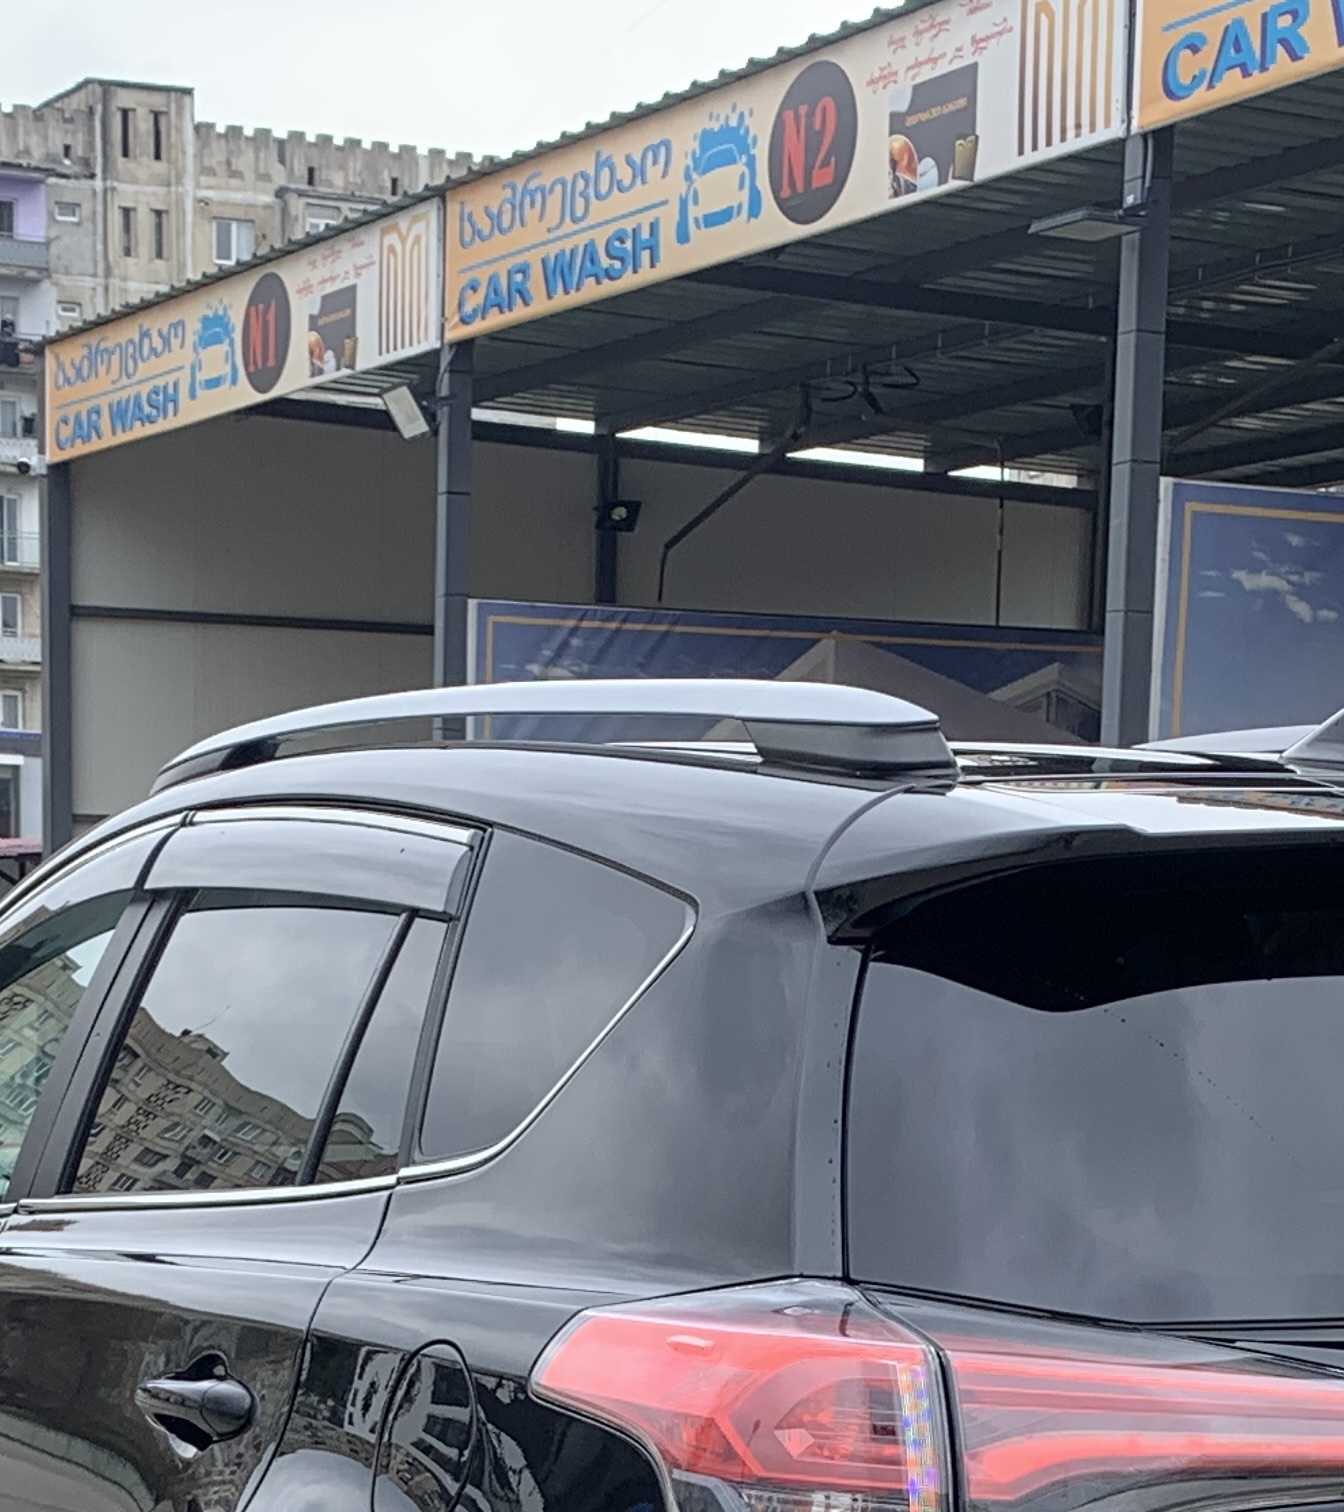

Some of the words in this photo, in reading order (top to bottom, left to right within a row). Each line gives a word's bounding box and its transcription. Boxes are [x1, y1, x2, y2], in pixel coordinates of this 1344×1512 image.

[1161, 0, 1311, 102] CAR
[458, 137, 673, 249] სამრეცხაო
[778, 96, 837, 199] N2
[458, 259, 532, 325] CAR
[544, 217, 662, 302] WASH
[54, 319, 186, 391] სამრეცხაო
[247, 296, 277, 373] N1
[55, 403, 103, 451] CAR
[109, 382, 180, 438] WASH
